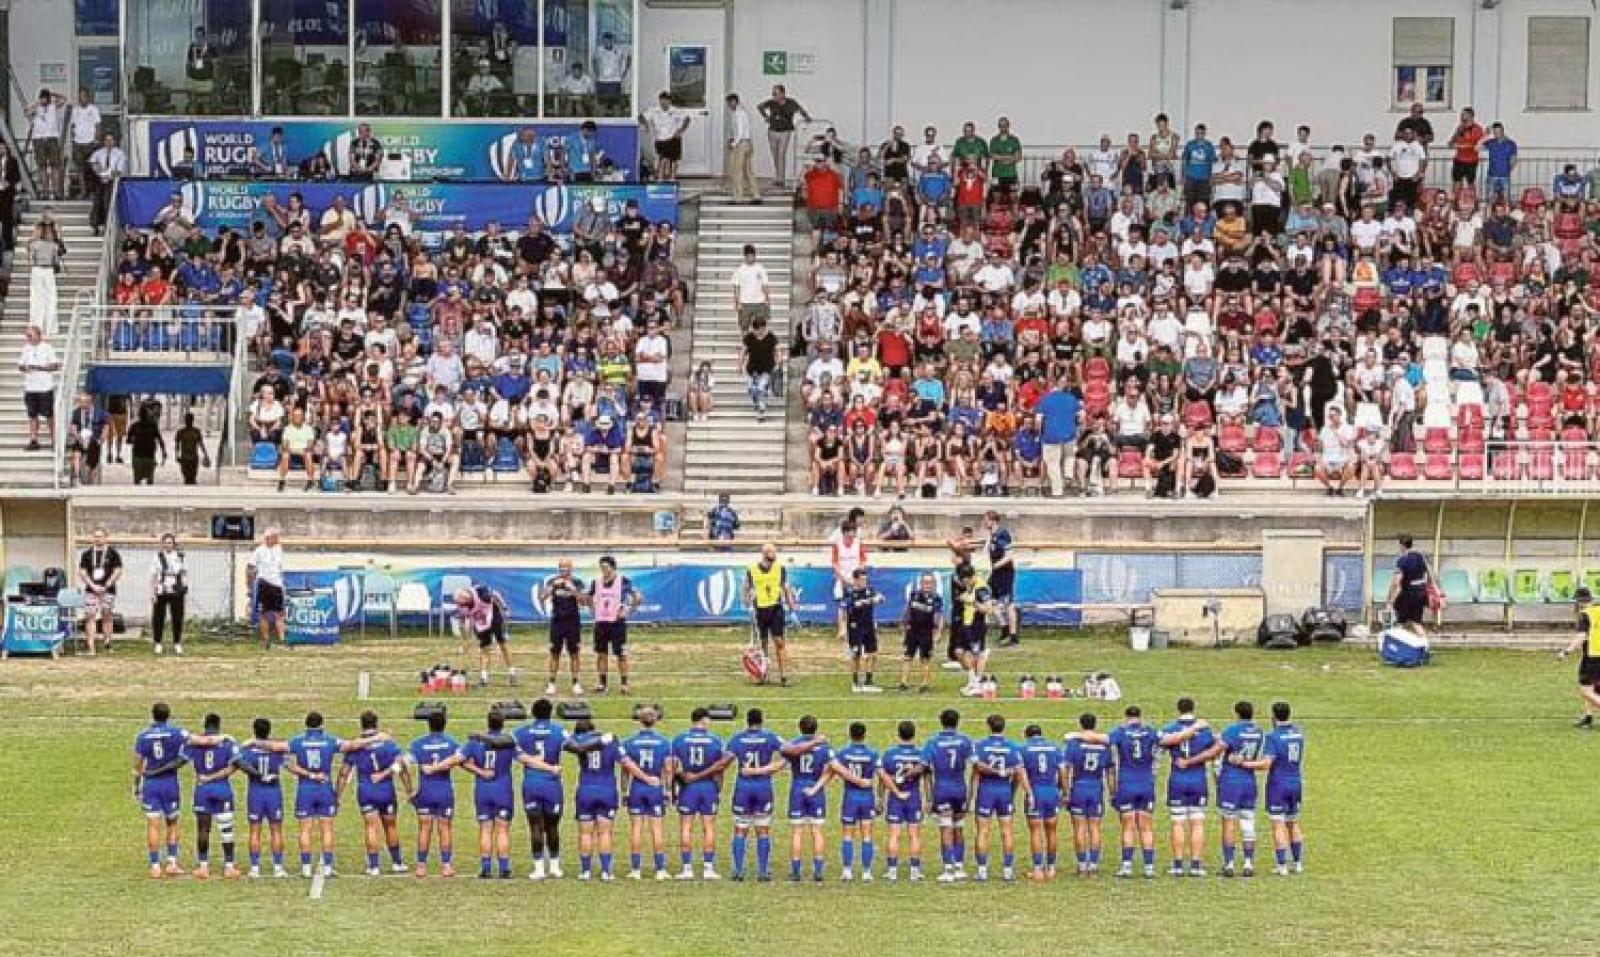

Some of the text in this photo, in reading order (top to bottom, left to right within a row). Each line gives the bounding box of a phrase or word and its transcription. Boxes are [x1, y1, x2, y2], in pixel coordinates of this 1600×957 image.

[205, 133, 253, 144] WORLD
[209, 195, 261, 210] RUGBY
[153, 740, 163, 760] 6
[946, 748, 956, 769] 7
[1132, 740, 1142, 759] 3
[370, 752, 379, 771] 1
[799, 754, 813, 773] 12
